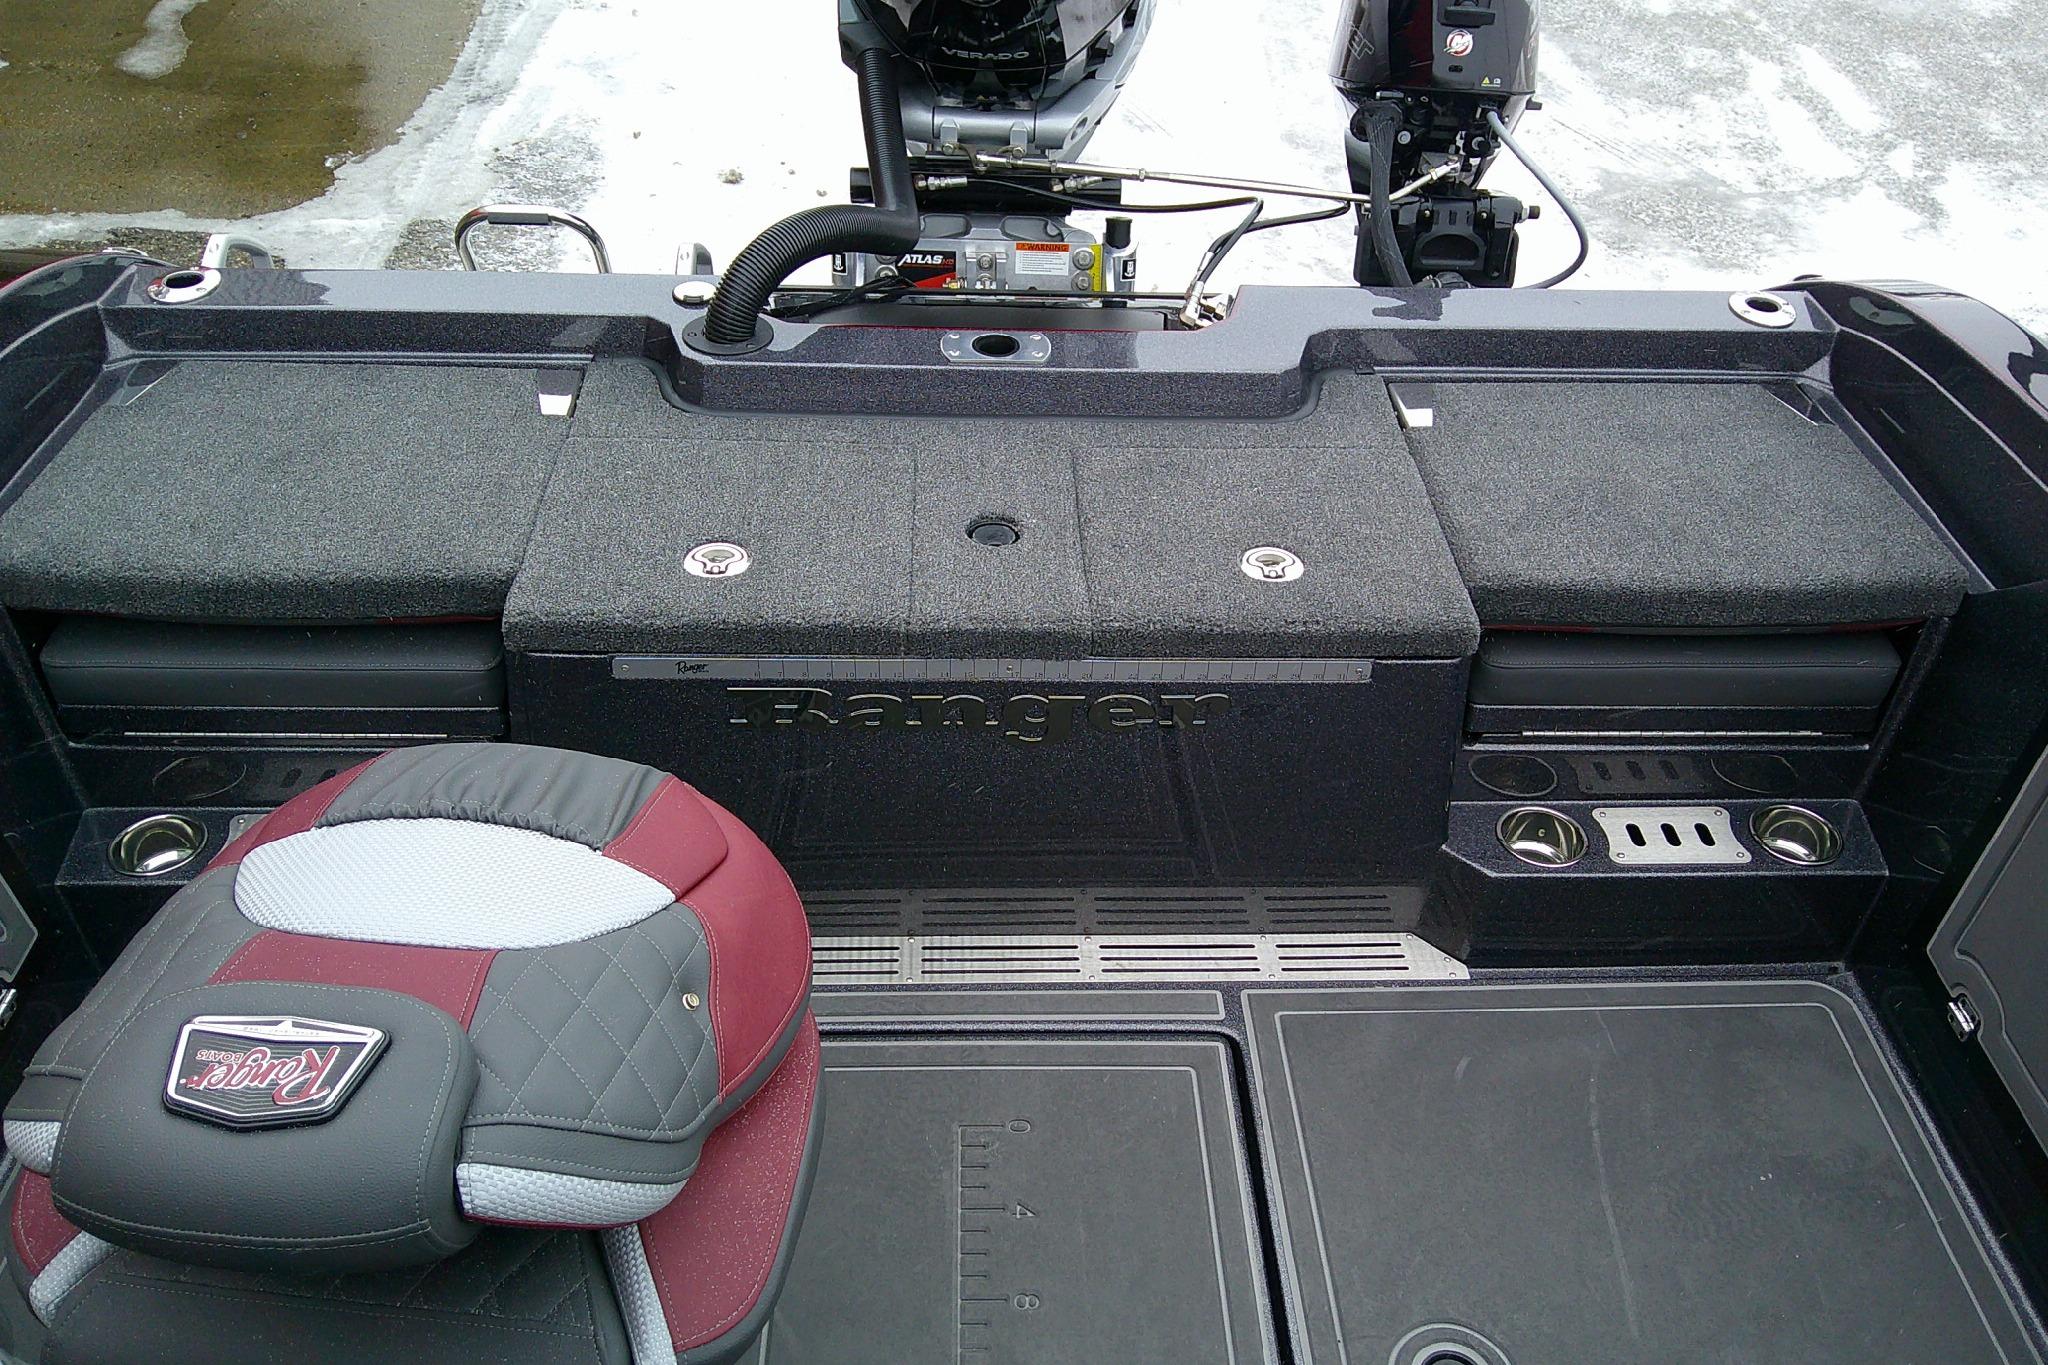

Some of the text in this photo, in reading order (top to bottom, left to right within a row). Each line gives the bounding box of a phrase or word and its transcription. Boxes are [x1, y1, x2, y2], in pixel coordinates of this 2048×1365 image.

[941, 46, 1030, 60] VERADO
[1027, 243, 1069, 252] WARNING
[897, 253, 943, 267] ATLAS
[675, 661, 708, 675] Ranger
[727, 687, 1232, 743] Ranger
[196, 1049, 243, 1063] BOATS
[181, 1046, 340, 1105] Ranger
[1012, 1202, 1036, 1219] 4
[1014, 1293, 1040, 1309] 8
